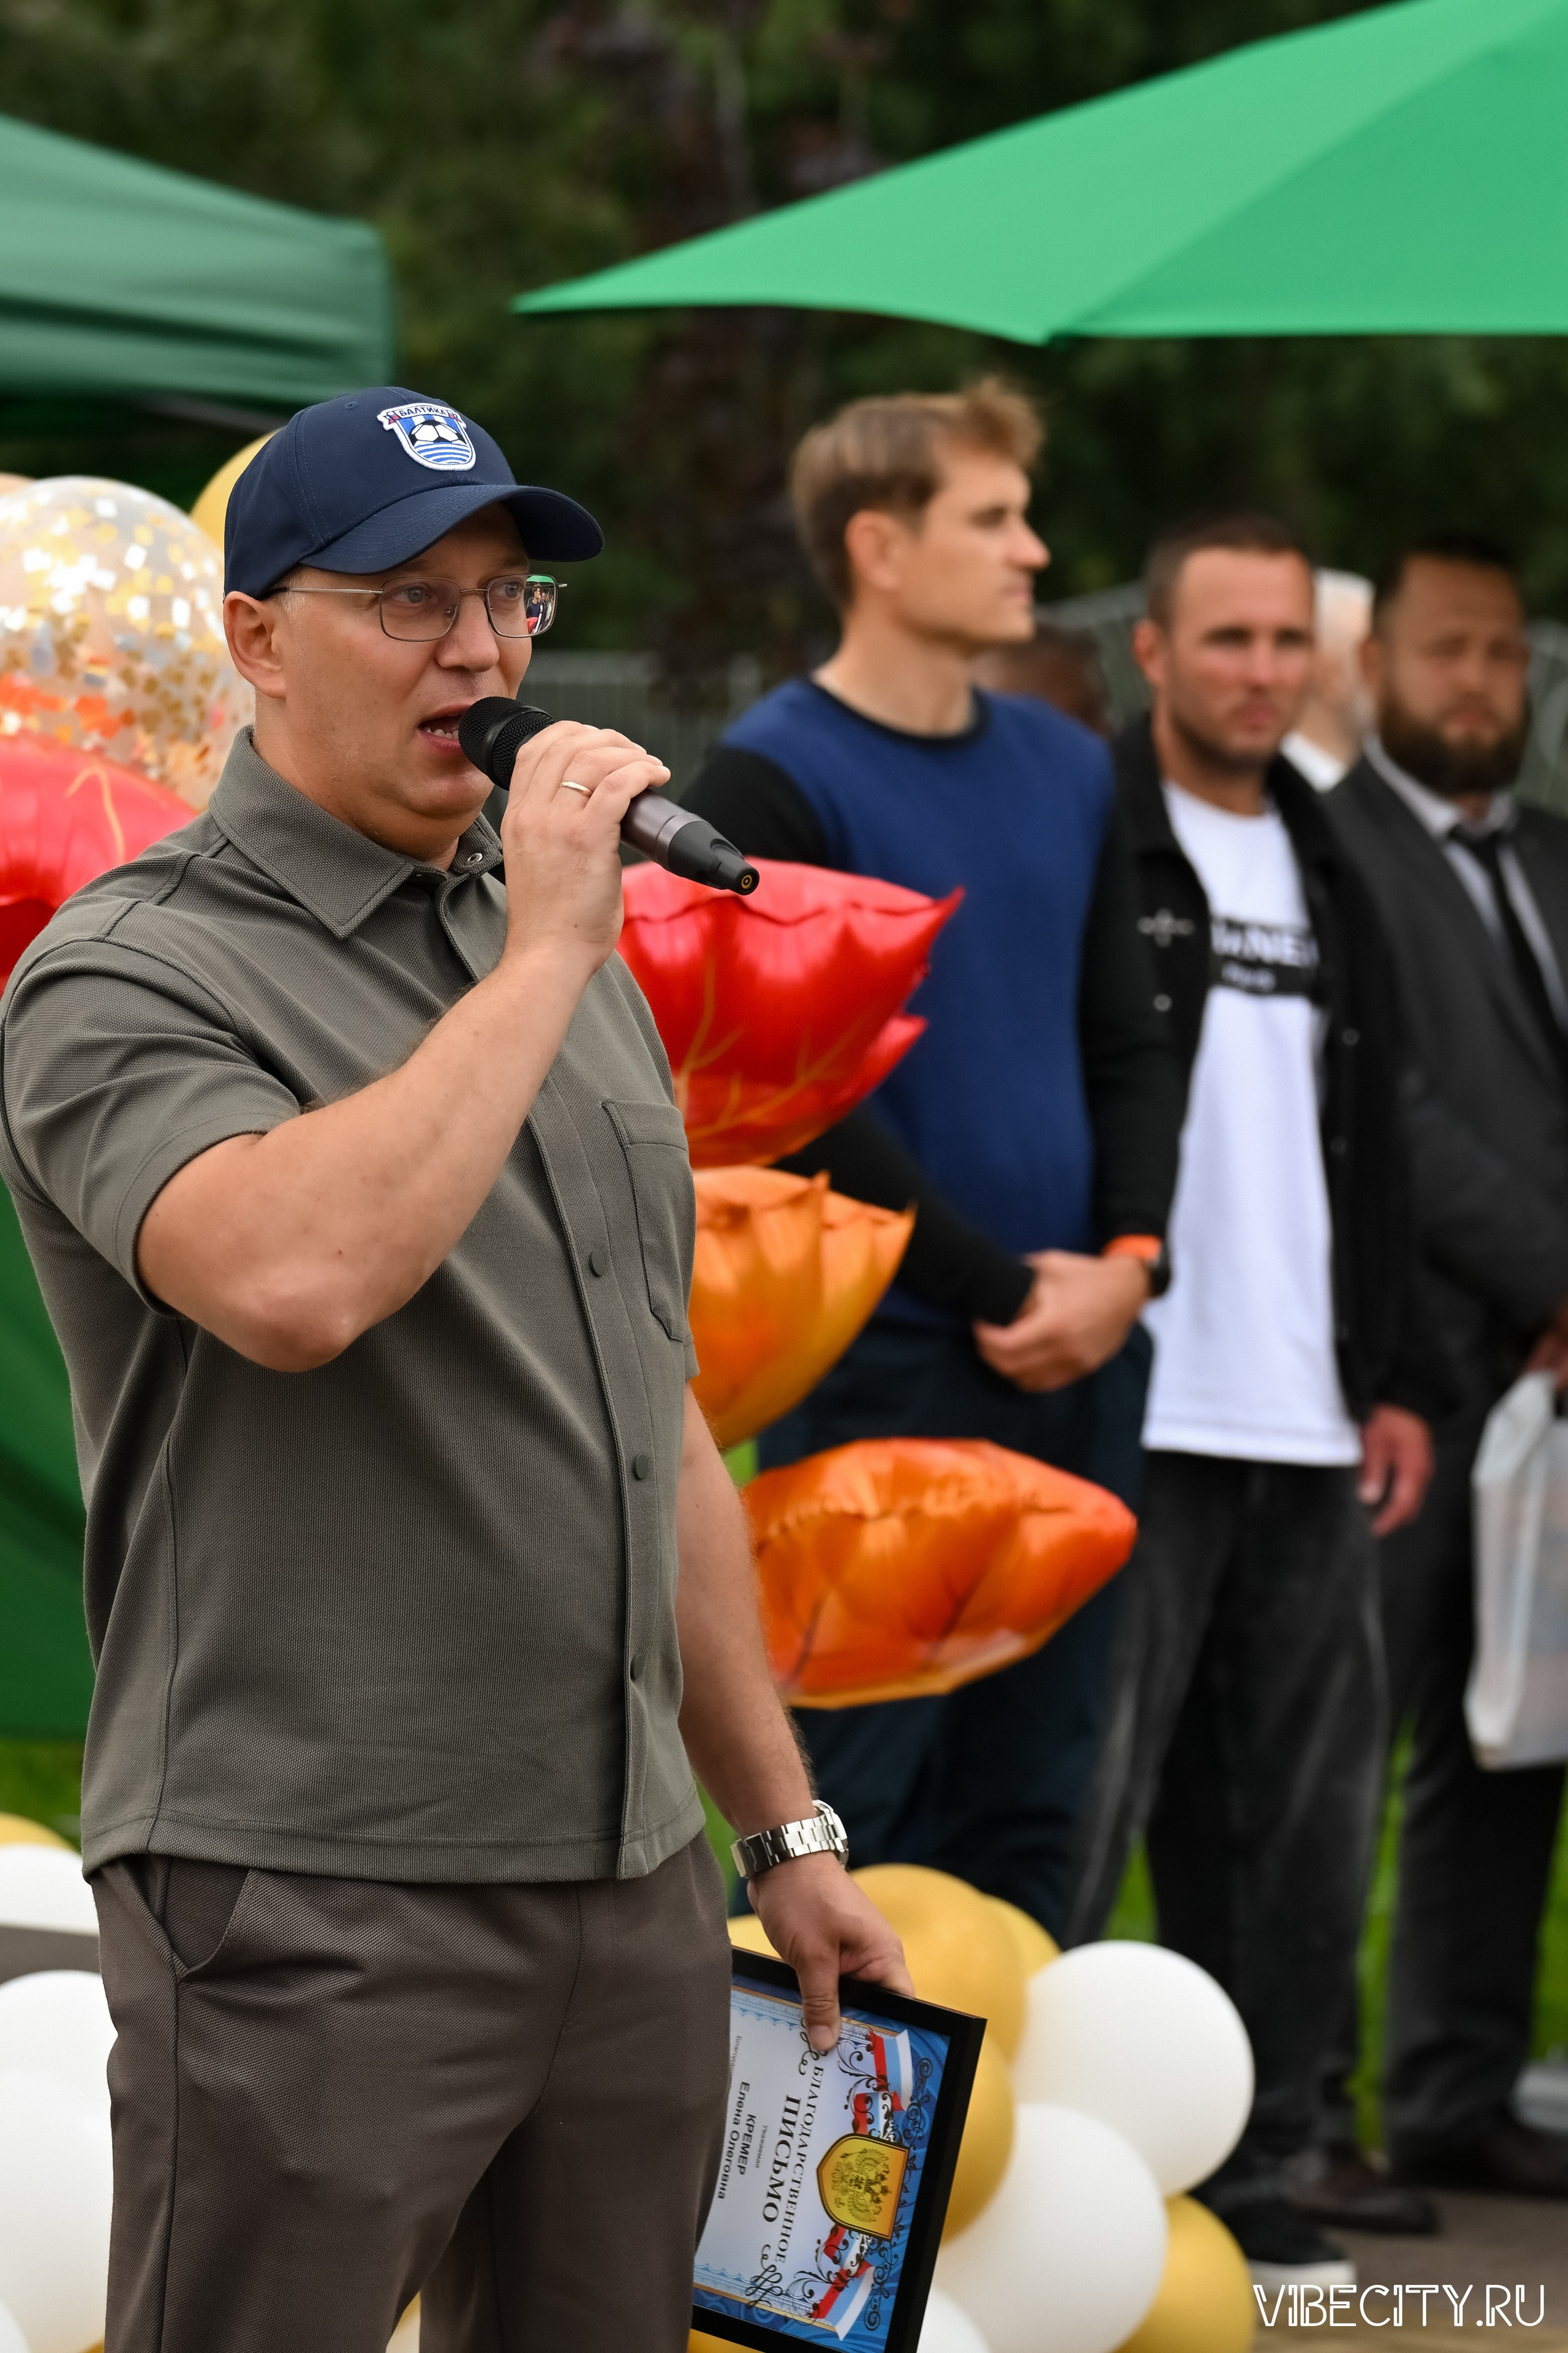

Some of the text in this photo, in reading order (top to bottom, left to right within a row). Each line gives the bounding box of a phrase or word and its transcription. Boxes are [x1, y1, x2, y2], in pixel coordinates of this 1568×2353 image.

[399, 407, 447, 417] БАЛТИКА
[718, 2081, 750, 2199] Елена Олеговна
[736, 2114, 757, 2175] КРЕМЕР
[762, 2093, 801, 2223] ПИСЬМО
[775, 2066, 824, 2264] БЛАГОДАРСТВЕННОЕ
